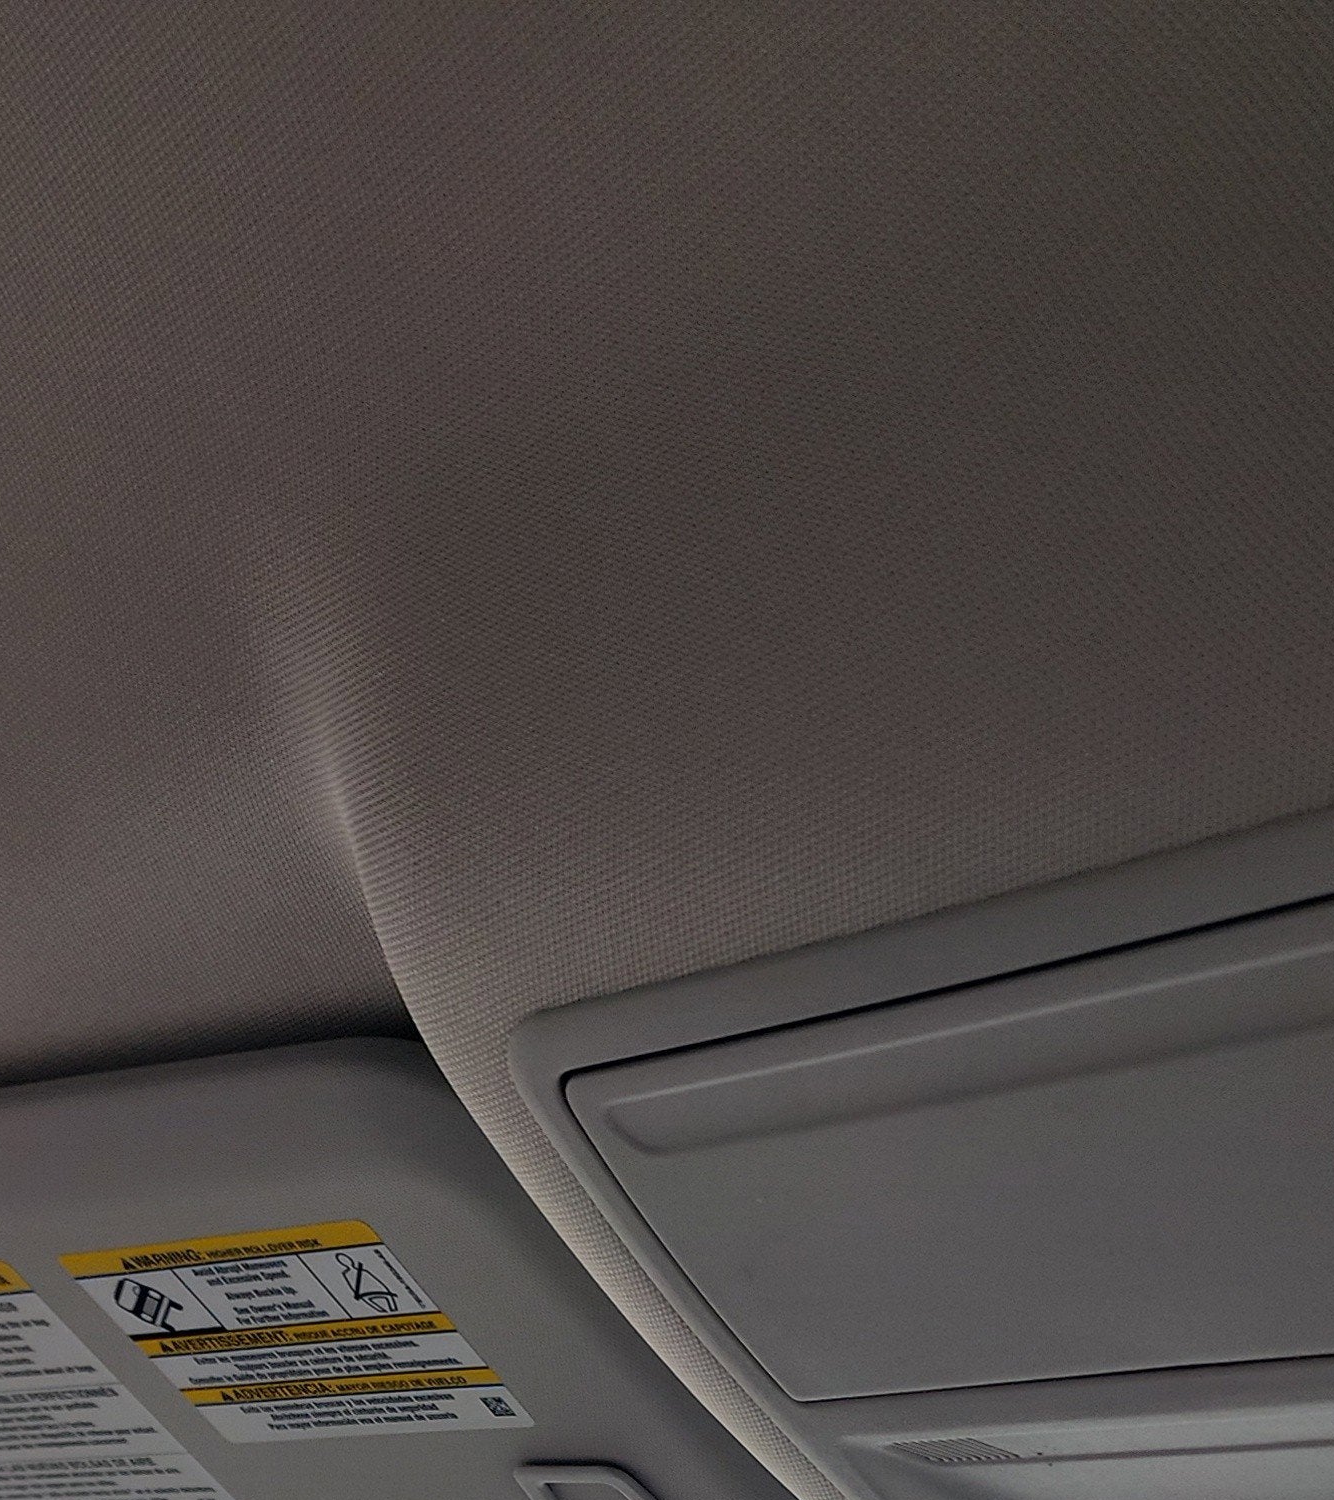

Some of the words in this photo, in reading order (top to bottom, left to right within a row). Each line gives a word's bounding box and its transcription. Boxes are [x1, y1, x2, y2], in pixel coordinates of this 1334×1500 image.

[131, 1248, 205, 1267] WARNING:
[206, 1247, 243, 1259] HIGHER
[243, 1241, 297, 1254] ROLLOVER
[296, 1238, 322, 1248] RISK
[192, 1267, 214, 1276] Avoid
[214, 1264, 243, 1274] Abrupt
[205, 1277, 222, 1285] and
[222, 1272, 261, 1283] Excessive
[224, 1290, 255, 1300] Always
[253, 1287, 282, 1296] Buckle
[283, 1299, 314, 1309] Manual
[171, 1330, 293, 1351] AVERTISSEMENT:
[293, 1330, 330, 1340] RISQUE
[330, 1327, 366, 1337] ACCRU
[381, 1320, 437, 1332] CAPOTAGE
[232, 1382, 336, 1399] ADVERTENCIA:
[337, 1383, 371, 1391] MAYOR
[372, 1380, 410, 1389] RIESGO
[424, 1375, 466, 1386] VUELCO
